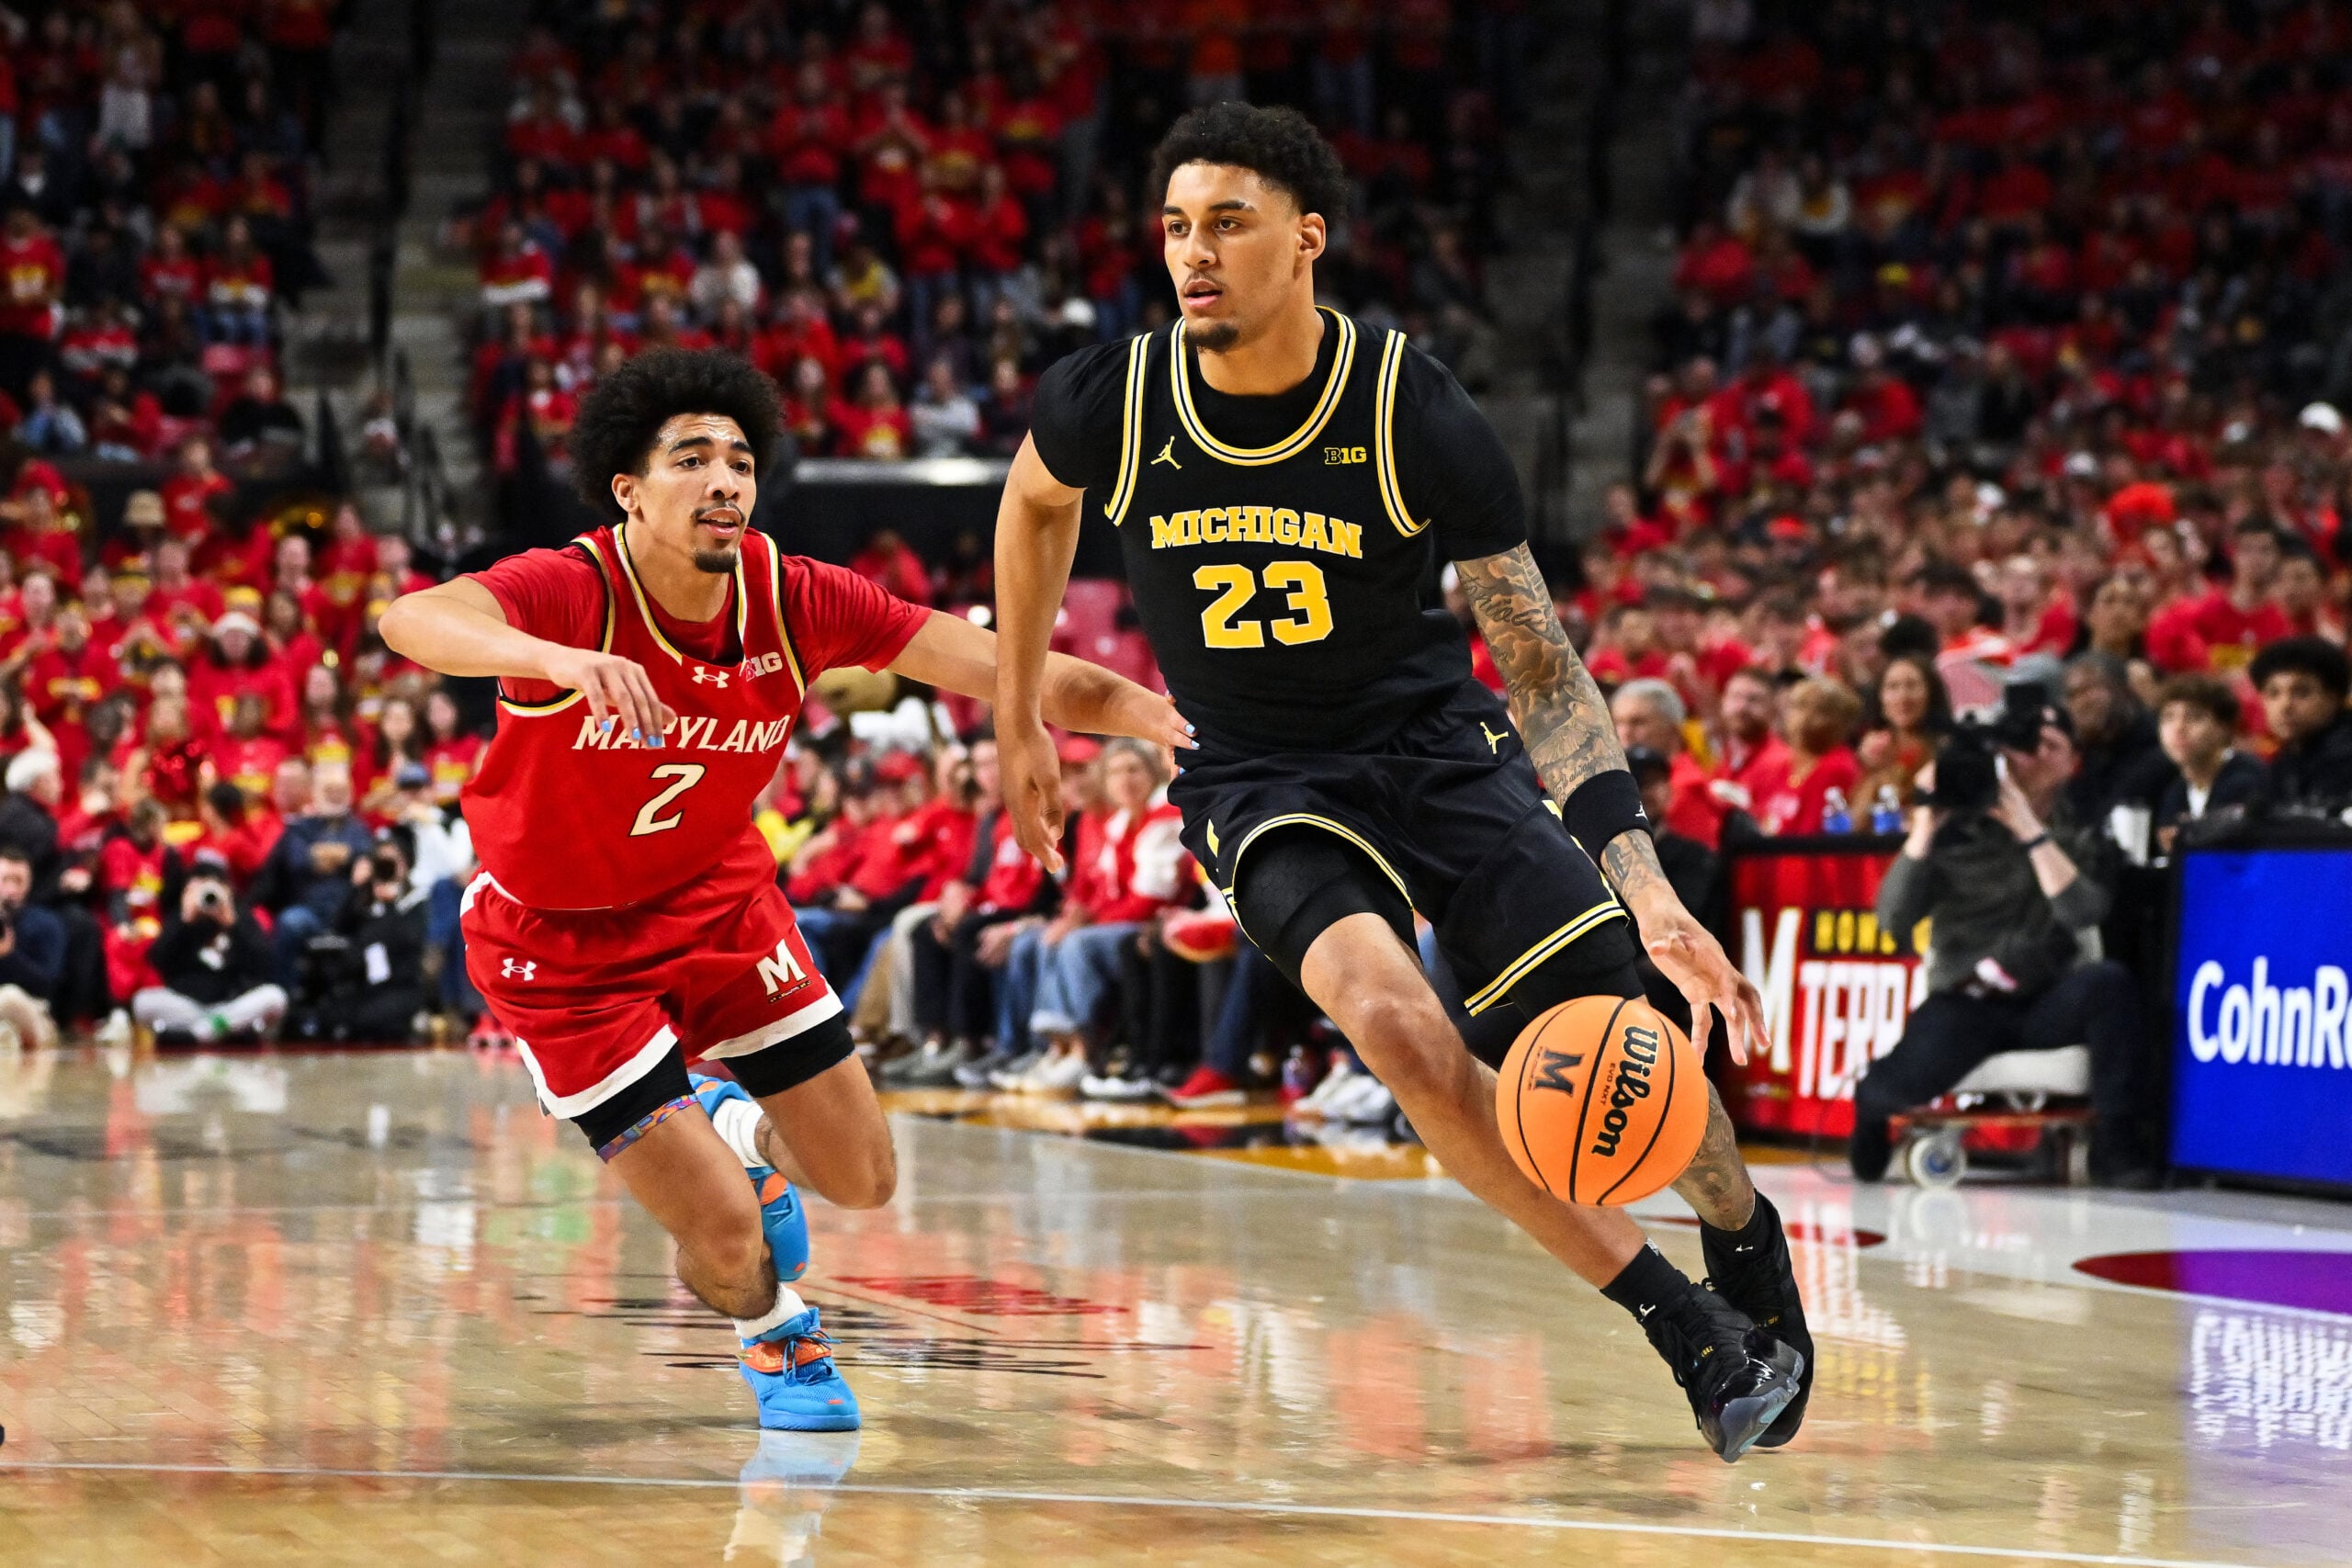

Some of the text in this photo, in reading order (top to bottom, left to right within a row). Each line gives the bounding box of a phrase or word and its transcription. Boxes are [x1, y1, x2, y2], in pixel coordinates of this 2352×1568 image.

[1149, 505, 1363, 558] MICHIGAN
[1193, 560, 1334, 649] 23
[628, 762, 706, 838] 2
[755, 938, 808, 997] M
[2188, 955, 2352, 1069] CohnR
[1533, 1046, 1586, 1098] M
[1591, 1025, 1659, 1158] Wilson
[1600, 1062, 1616, 1106] EVO NXT
